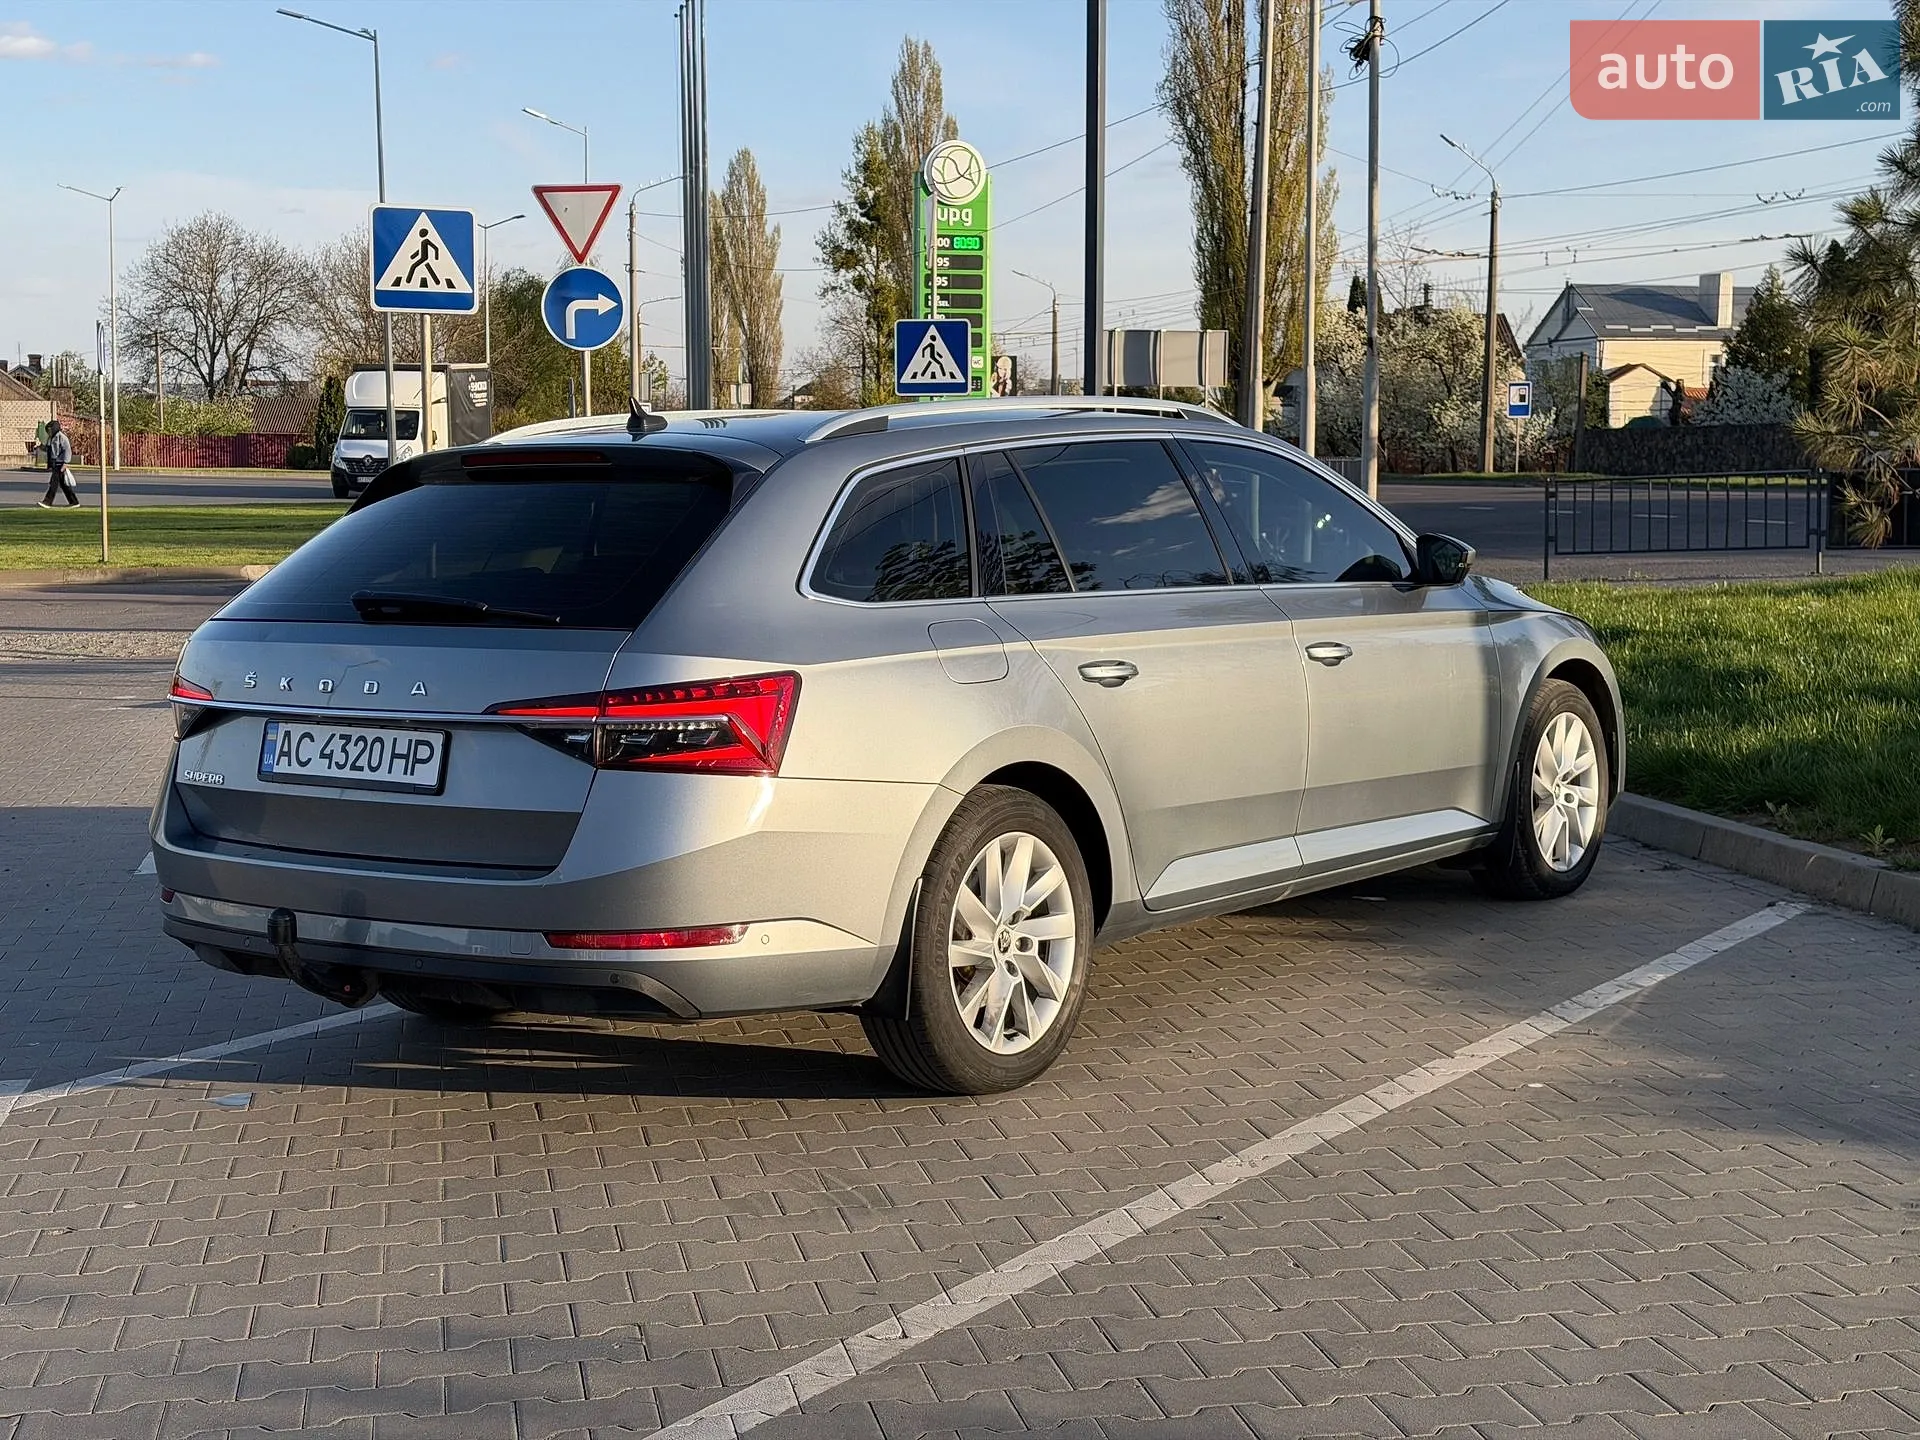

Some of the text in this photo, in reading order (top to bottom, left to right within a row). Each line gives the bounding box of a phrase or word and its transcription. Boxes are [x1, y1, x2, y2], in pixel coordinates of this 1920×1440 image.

[937, 207, 972, 227] upg
[243, 671, 428, 697] ŠKODA
[264, 753, 274, 766] UA
[275, 731, 434, 777] AC 4320 HP
[184, 769, 224, 785] SUPERB
